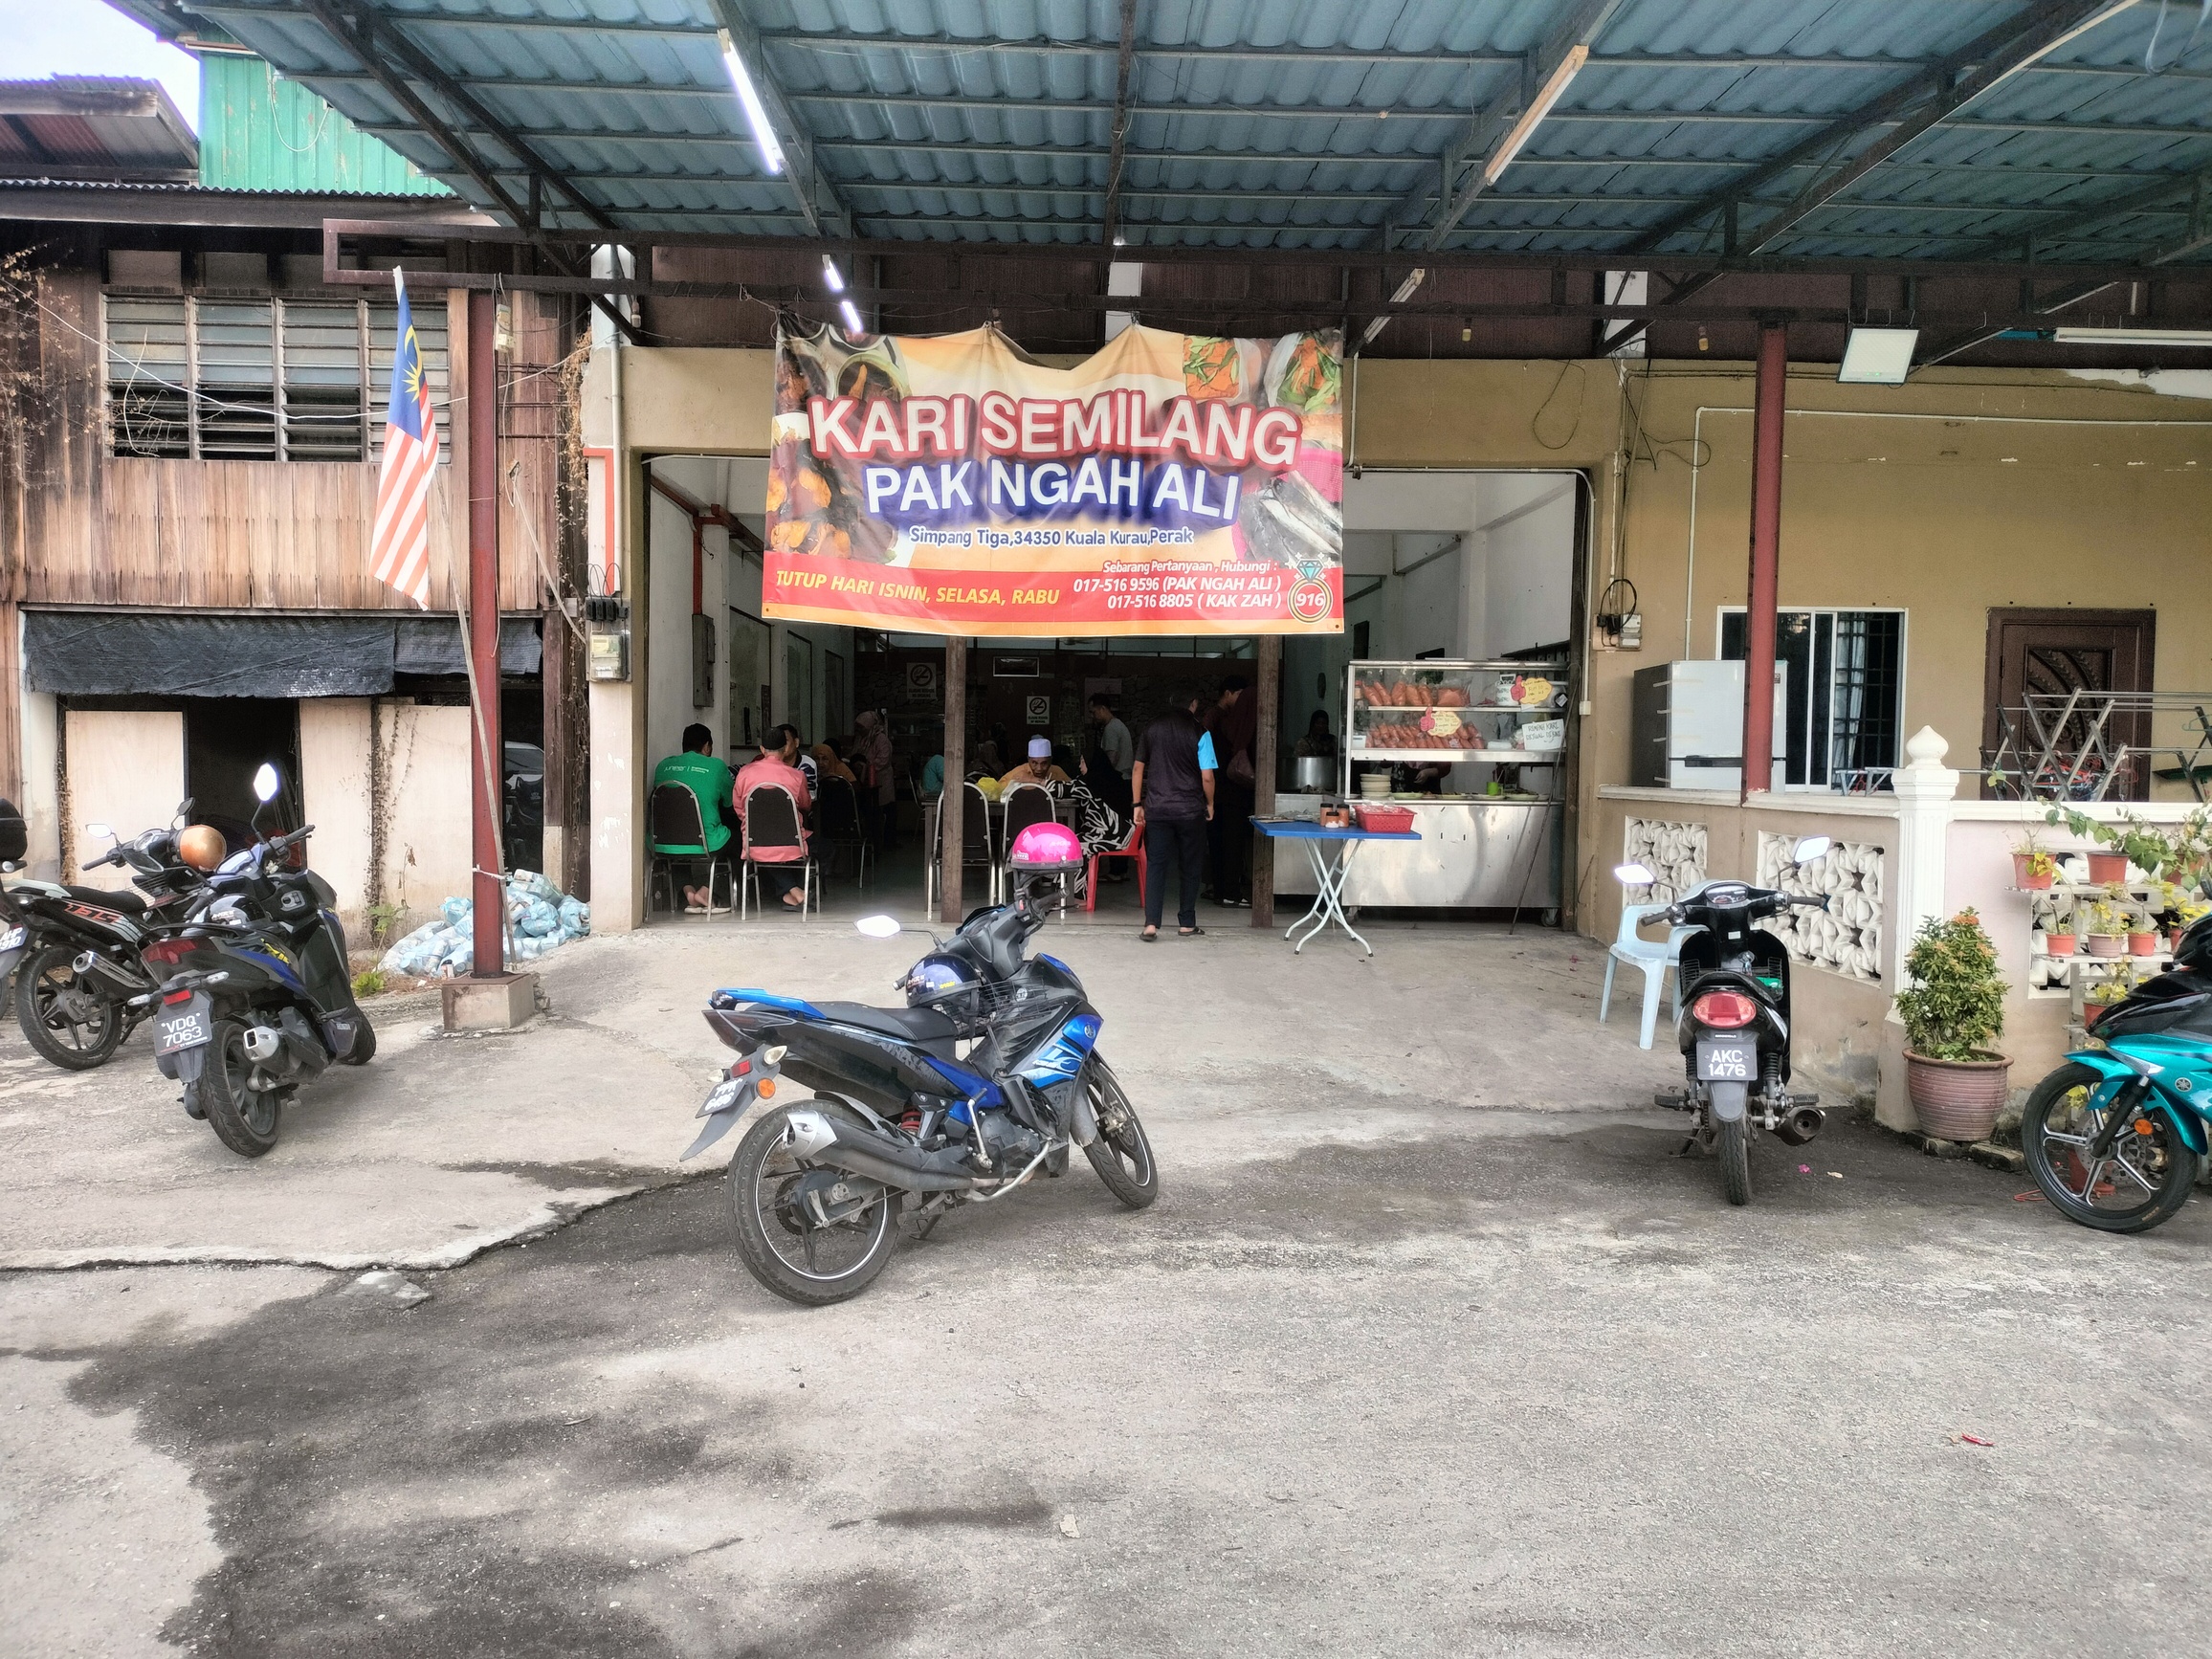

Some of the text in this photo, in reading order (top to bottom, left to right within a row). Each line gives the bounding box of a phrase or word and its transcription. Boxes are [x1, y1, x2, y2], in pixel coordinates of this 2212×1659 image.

[809, 388, 1301, 467] KARI SEMILANG
[865, 456, 1240, 520] PAK NGAH ALI
[910, 527, 972, 546] Simpang
[1065, 530, 1106, 544] Kuala
[1103, 561, 1149, 574] Sebarang
[1221, 560, 1272, 573] Hubungi
[777, 570, 1061, 606] TUTUP HARI ISNIN, SELASA, RABU
[1073, 578, 1127, 592] 017-516
[1130, 577, 1160, 591] 9596
[1162, 576, 1197, 592] (PAK
[1200, 576, 1246, 591] NGAH
[1107, 595, 1158, 609] 017-516
[1159, 593, 1194, 608] 8805
[1206, 593, 1238, 608] KAK
[1240, 593, 1273, 608] ZAH
[1295, 592, 1325, 608] 916
[166, 1014, 197, 1033] VDQ
[163, 1026, 203, 1048] 7063
[1711, 1049, 1744, 1063] AKC
[1708, 1063, 1747, 1077] 1476
